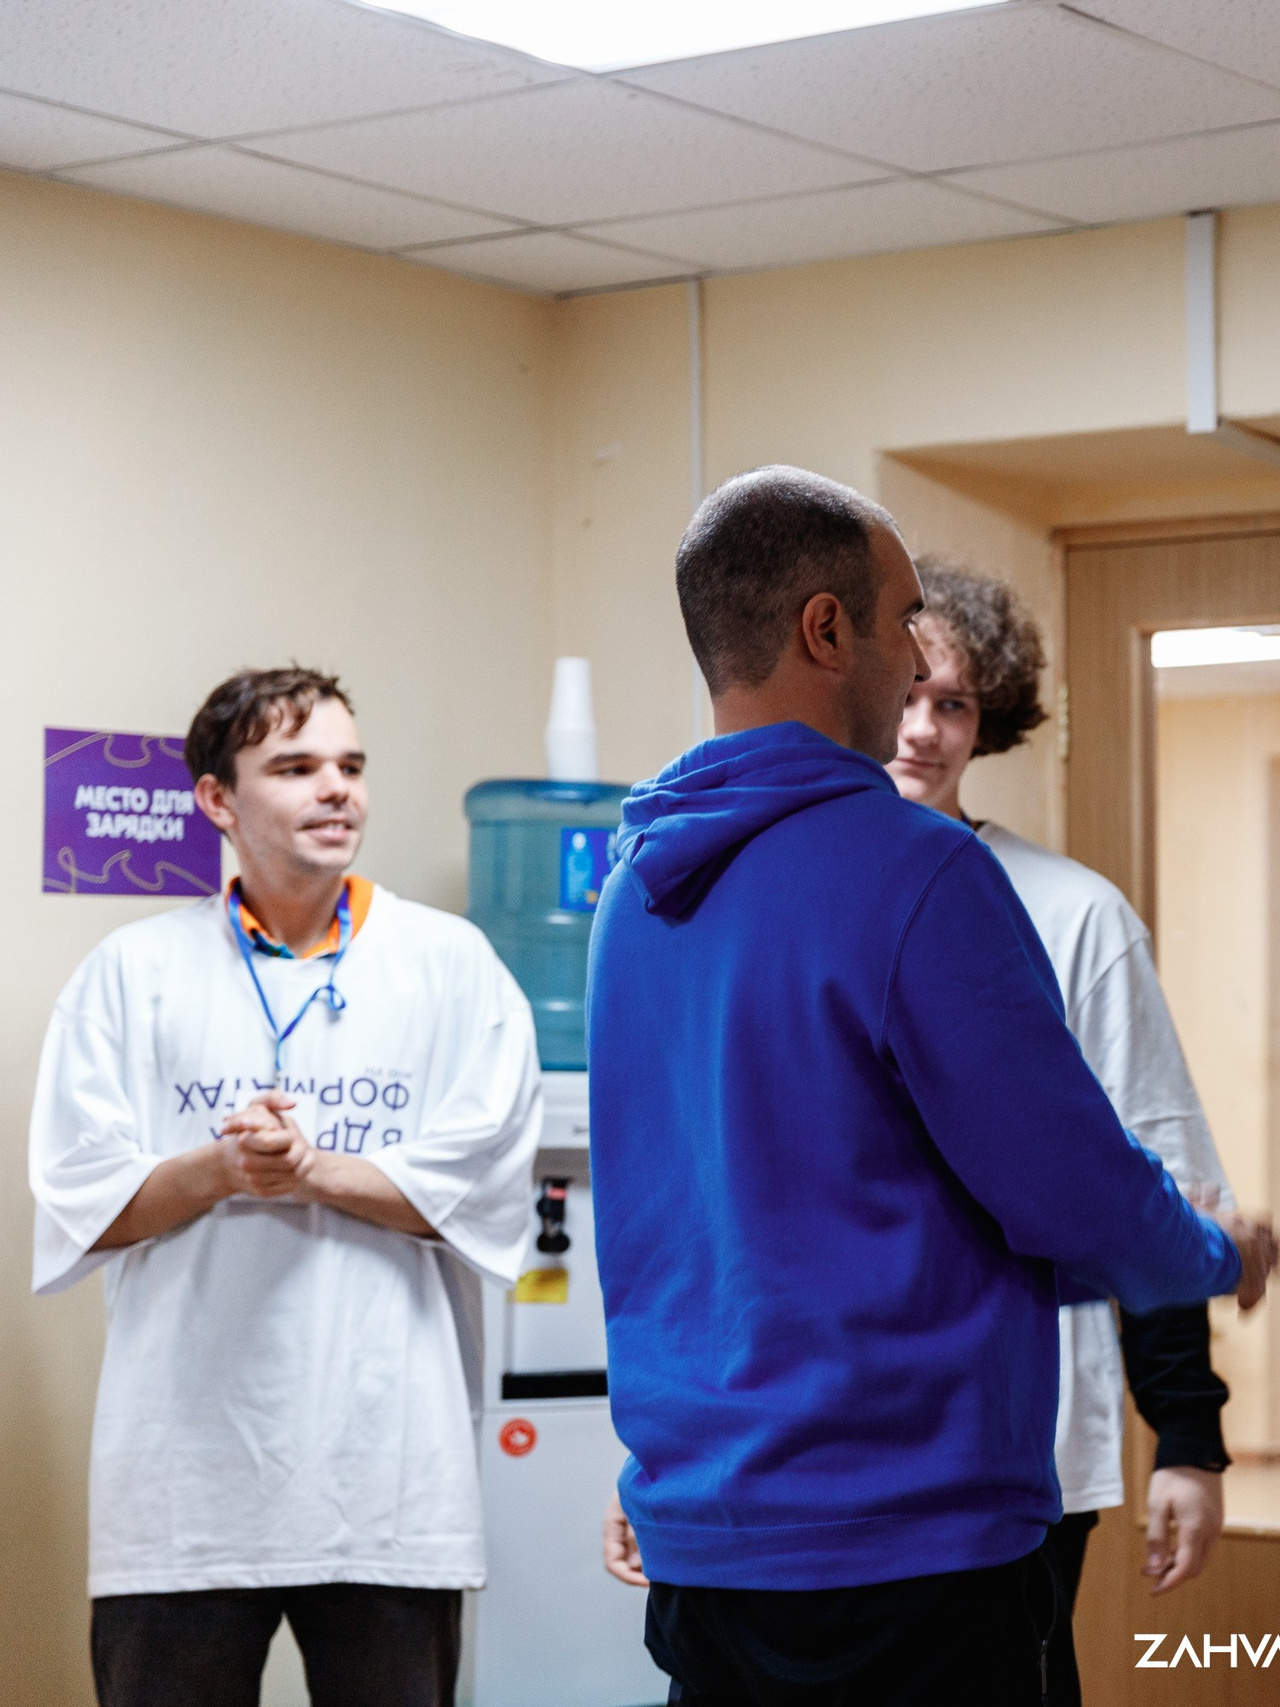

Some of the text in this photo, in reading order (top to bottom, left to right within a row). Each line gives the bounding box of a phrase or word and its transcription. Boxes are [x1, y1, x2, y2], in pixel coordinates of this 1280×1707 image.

[75, 785, 195, 815] МЕСТО ДЛЯ
[86, 812, 184, 843] ЗАРЯДКИ
